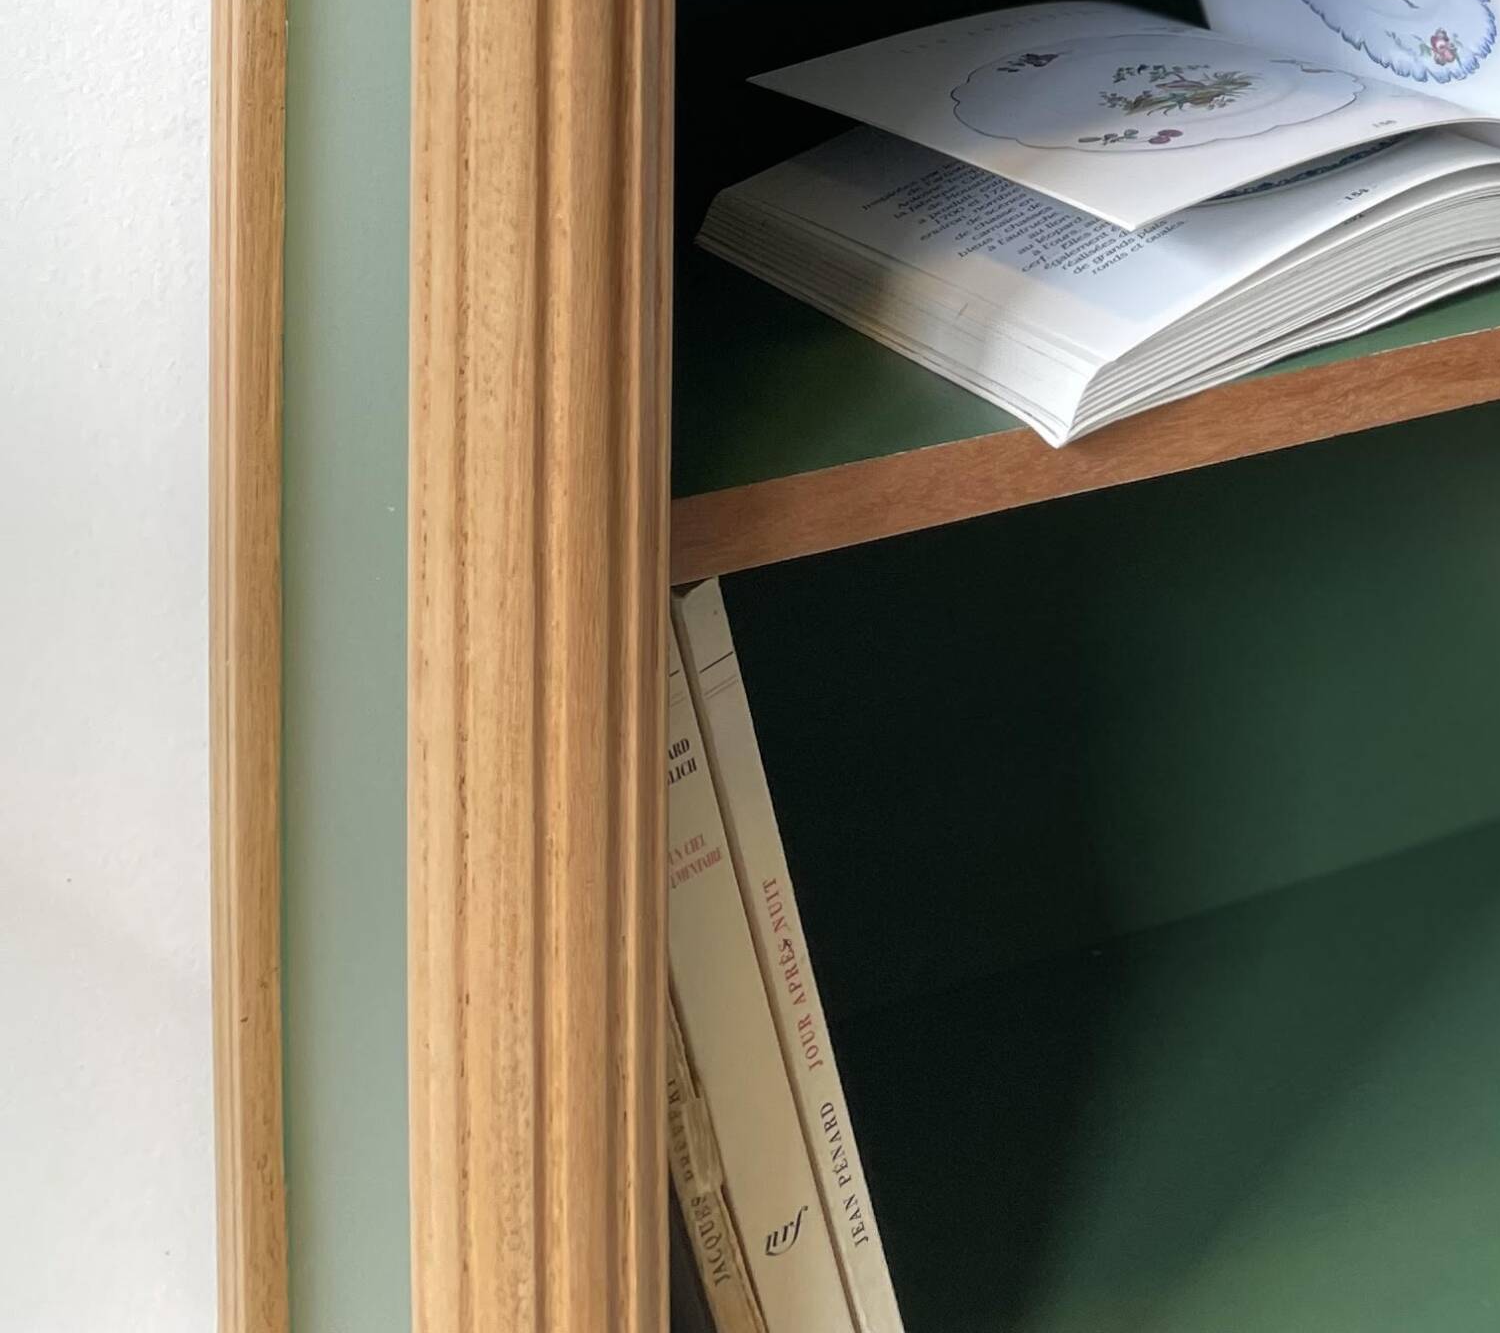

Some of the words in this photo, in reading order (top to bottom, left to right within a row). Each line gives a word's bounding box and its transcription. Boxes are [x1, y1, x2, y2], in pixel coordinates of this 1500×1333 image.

[1091, 237, 1141, 265] grands
[1136, 218, 1168, 240] plats
[1091, 252, 1129, 275] ronds
[762, 877, 788, 933] NUIT
[797, 1013, 823, 1072] JOUR
[820, 1101, 852, 1188] PÉNARD
[691, 1195, 731, 1286] JACQUES
[842, 1192, 869, 1247] JEAN
